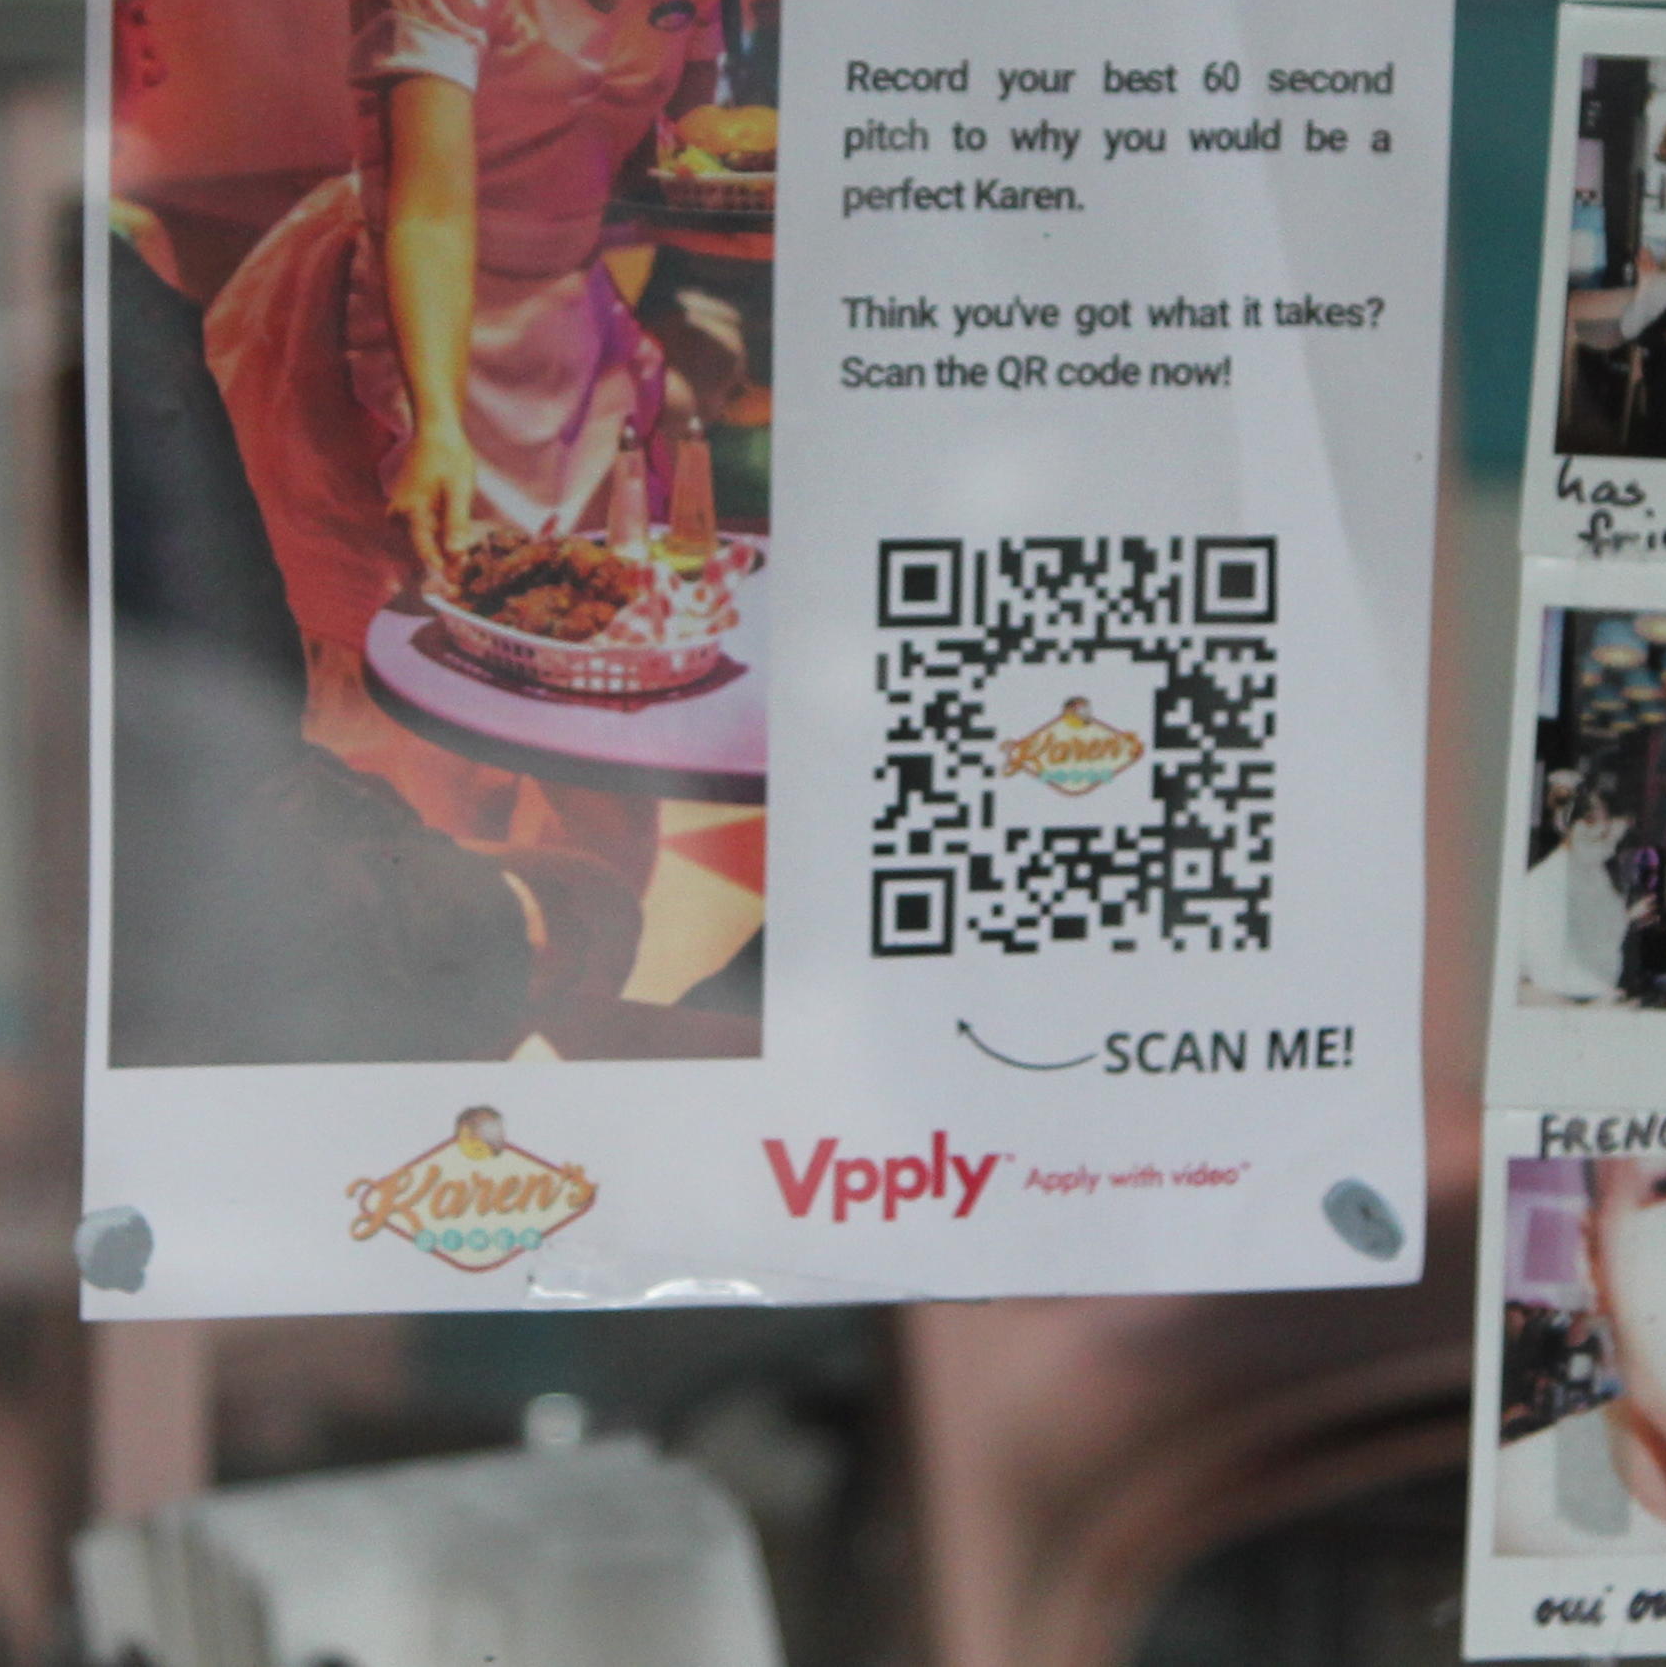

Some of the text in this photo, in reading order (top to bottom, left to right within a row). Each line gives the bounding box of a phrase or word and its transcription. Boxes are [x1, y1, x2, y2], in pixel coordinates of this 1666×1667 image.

[844, 58, 1395, 104] Record your best 60 second
[841, 117, 1393, 164] pitch to why you would be a
[841, 175, 1085, 221] perfect Karen.
[840, 292, 1386, 339] Think you've got what it takes?
[839, 352, 1232, 393] Scan the QR code now!
[1558, 455, 1645, 507] has
[1104, 1026, 1356, 1075] SCAN ME!
[1536, 1584, 1614, 1627] oui
